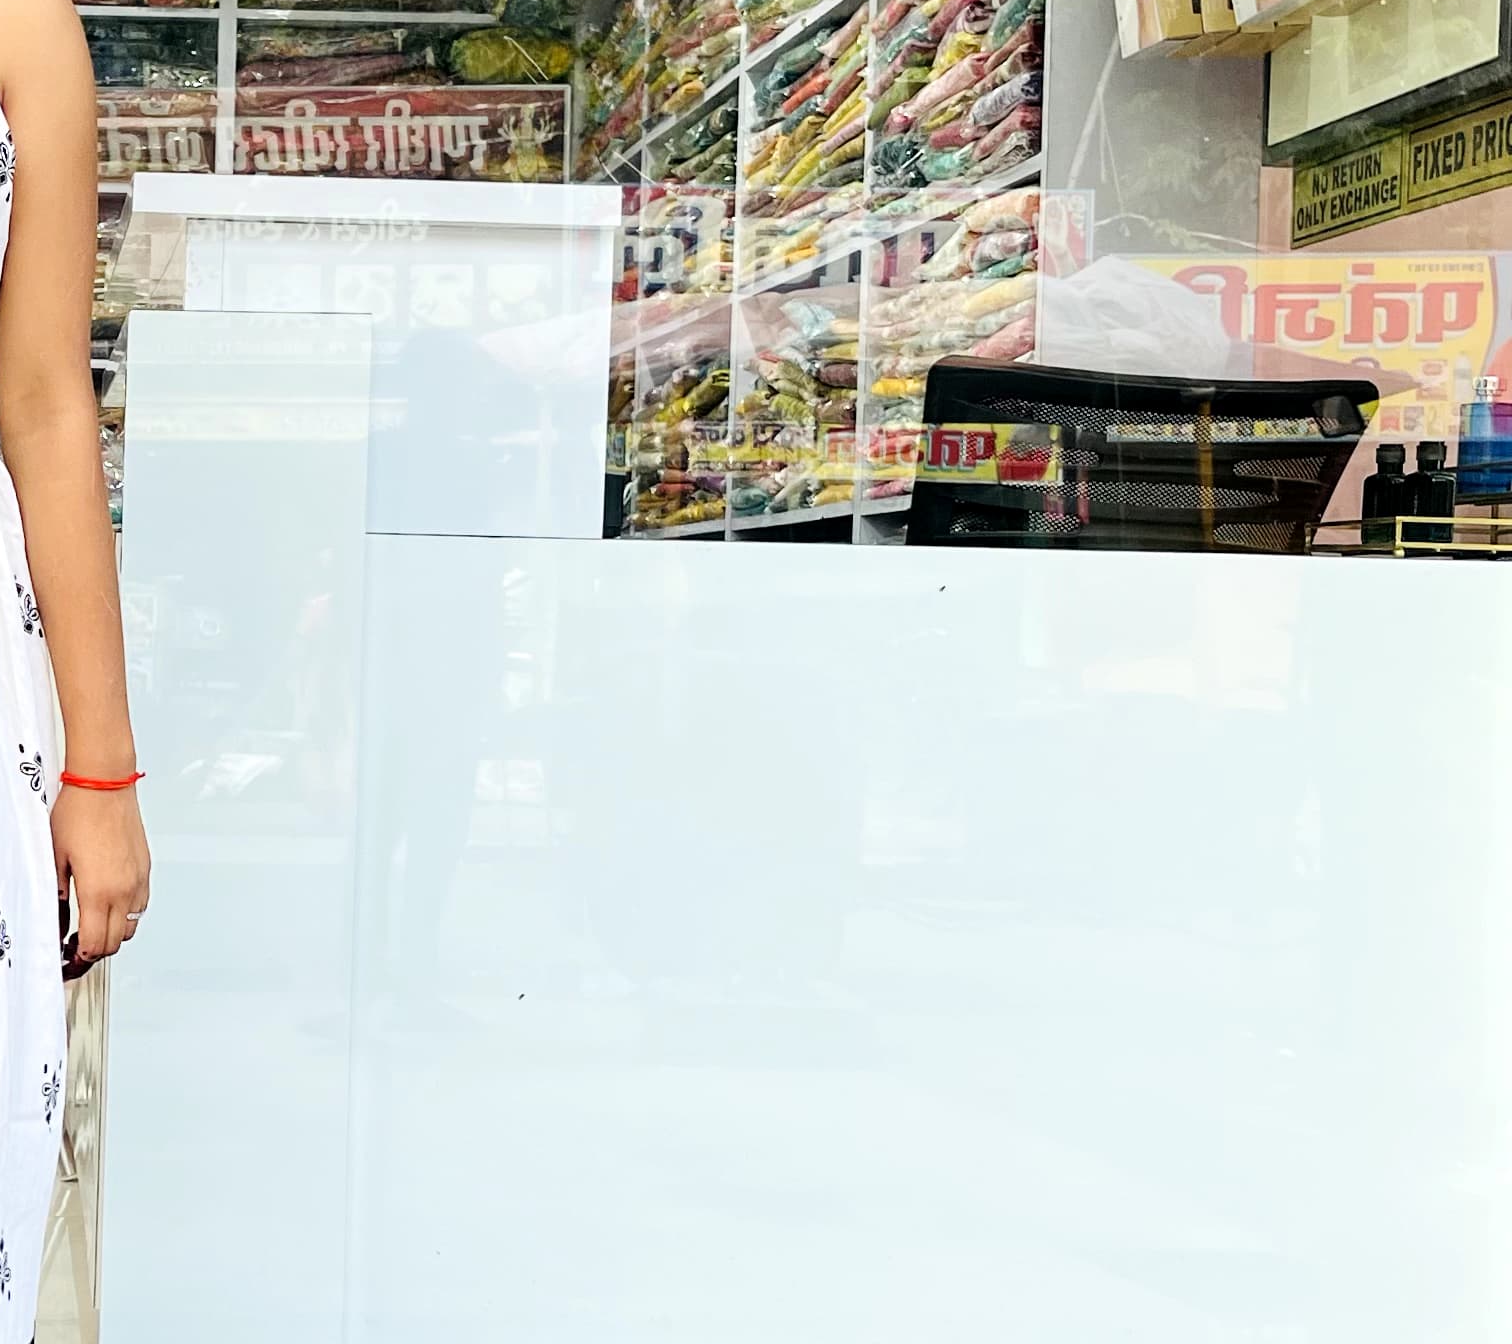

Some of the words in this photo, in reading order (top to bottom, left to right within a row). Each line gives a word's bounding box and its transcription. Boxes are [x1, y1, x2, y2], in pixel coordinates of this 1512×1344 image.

[1312, 171, 1329, 198] NO
[1331, 151, 1383, 191] RETURN
[1412, 130, 1466, 185] FIXED
[1296, 197, 1327, 231] ONLY
[1330, 174, 1399, 220] EXCHANGE
